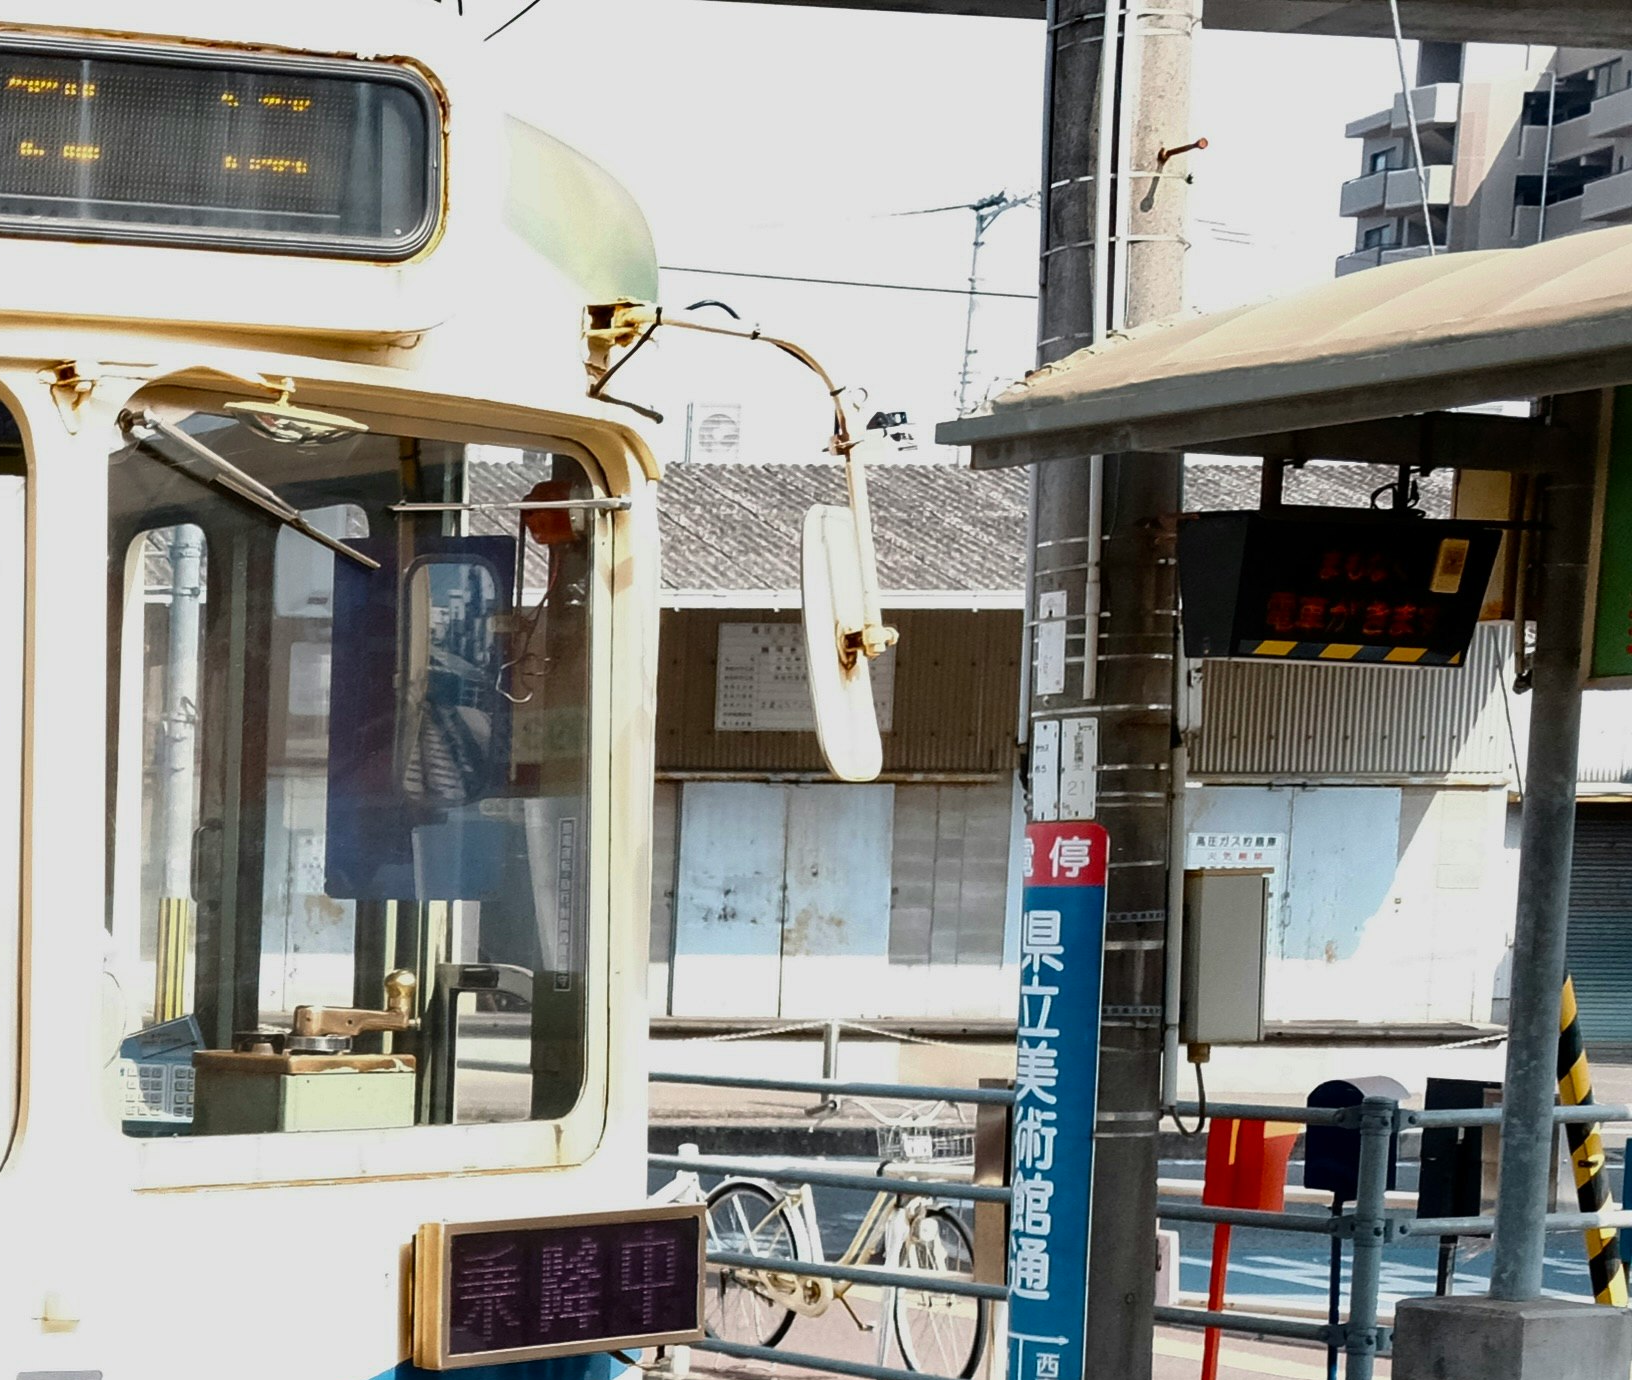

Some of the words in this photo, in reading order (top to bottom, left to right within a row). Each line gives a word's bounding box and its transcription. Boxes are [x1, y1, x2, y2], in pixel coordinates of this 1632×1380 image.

[1007, 909, 1065, 1302] 県立美術館通
